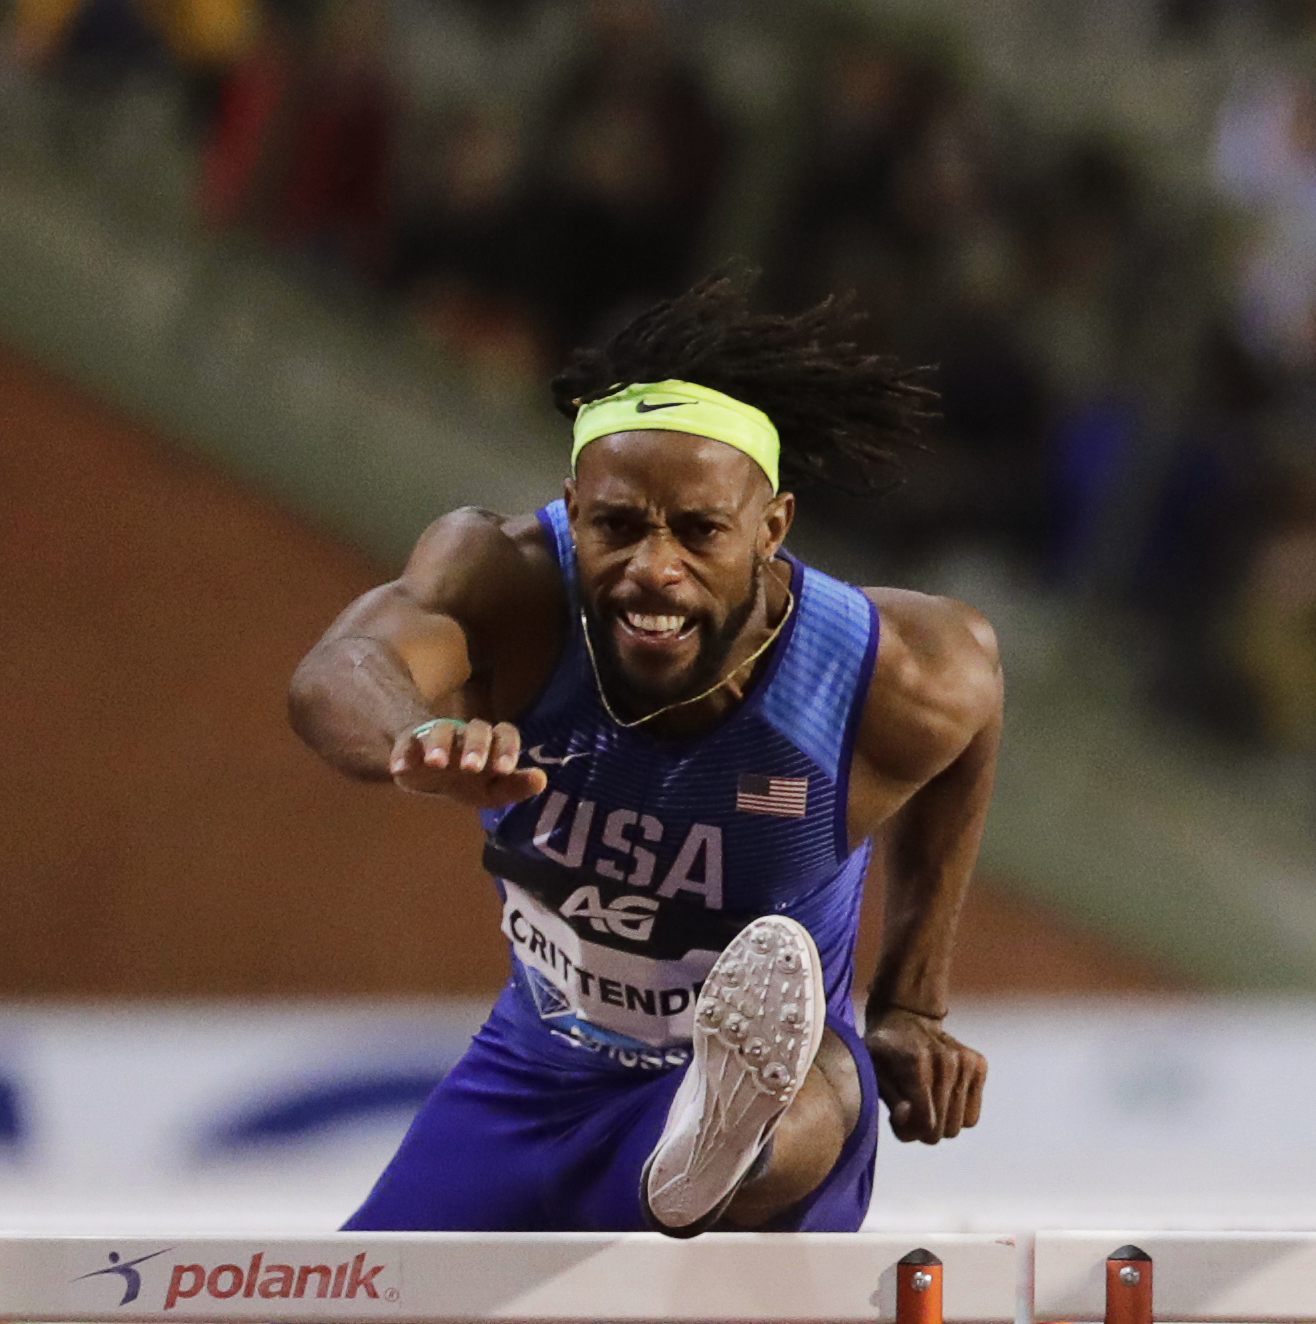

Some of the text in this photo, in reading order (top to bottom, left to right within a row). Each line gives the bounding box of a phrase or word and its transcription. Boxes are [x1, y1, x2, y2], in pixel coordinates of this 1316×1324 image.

[532, 790, 724, 910] USA
[509, 909, 702, 1017] CRITTEND
[163, 1251, 386, 1311] polanik
